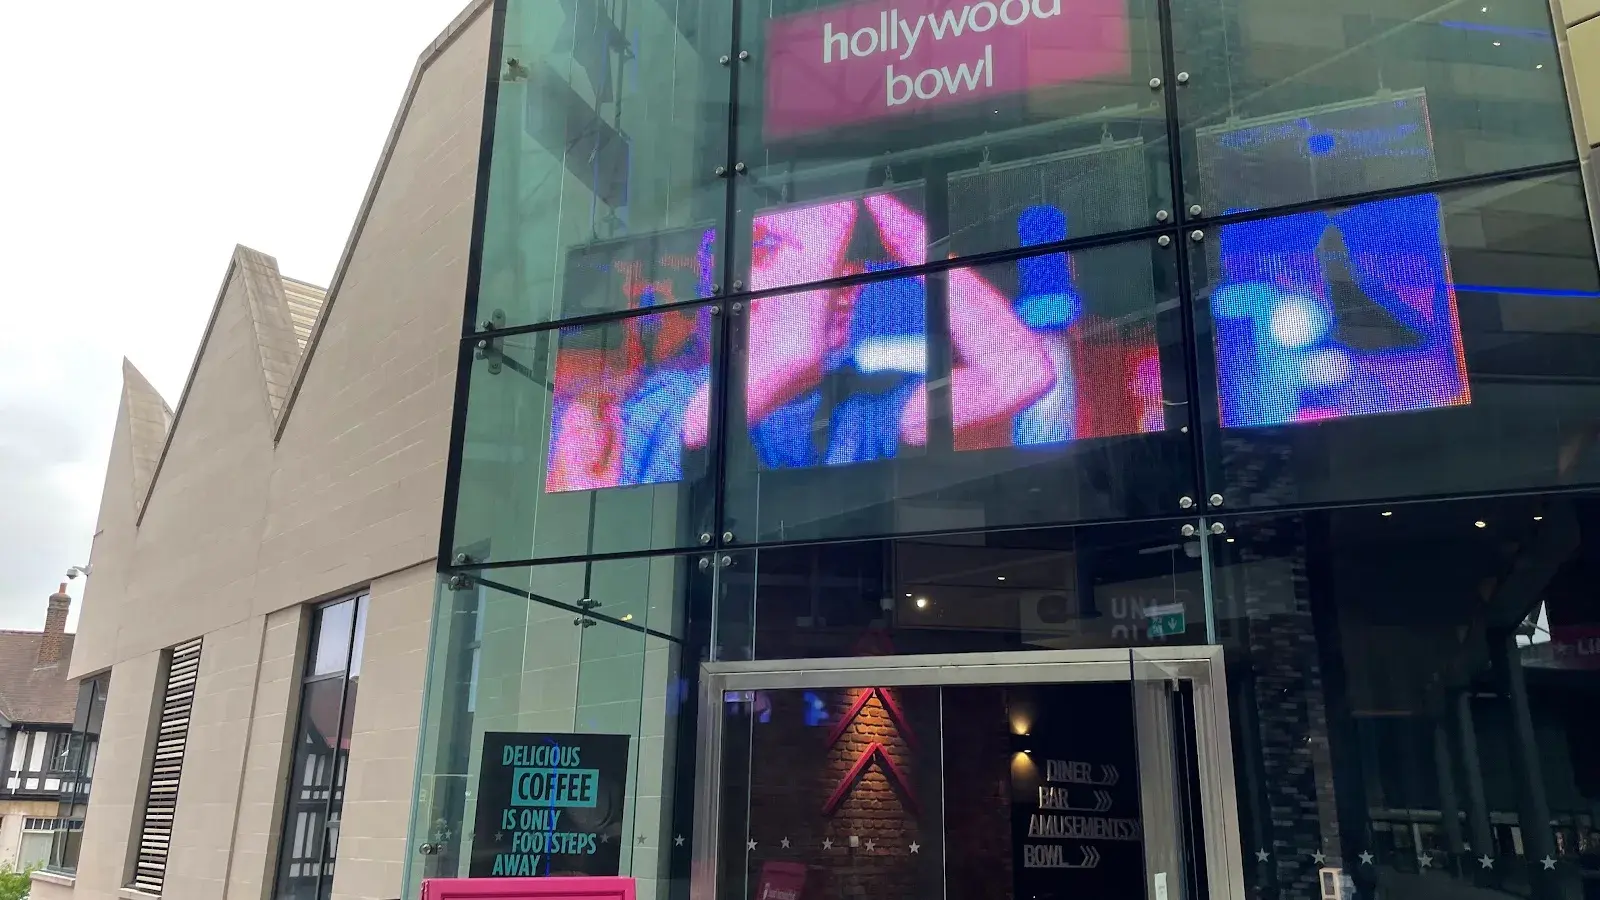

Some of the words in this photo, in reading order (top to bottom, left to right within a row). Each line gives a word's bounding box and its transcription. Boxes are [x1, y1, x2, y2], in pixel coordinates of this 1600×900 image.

[886, 45, 993, 106] bowl
[502, 745, 581, 767] DELICIOUS
[1046, 759, 1092, 782] DINER
[517, 772, 592, 802] COFFEE
[1038, 786, 1069, 808] BAR
[502, 808, 517, 830] IS
[520, 809, 561, 831] ONLY
[1028, 814, 1129, 839] AMUSEMENTS
[512, 832, 597, 855] FOOTSTEPS
[492, 853, 541, 876] AWAY
[1024, 844, 1069, 867] BOWL
